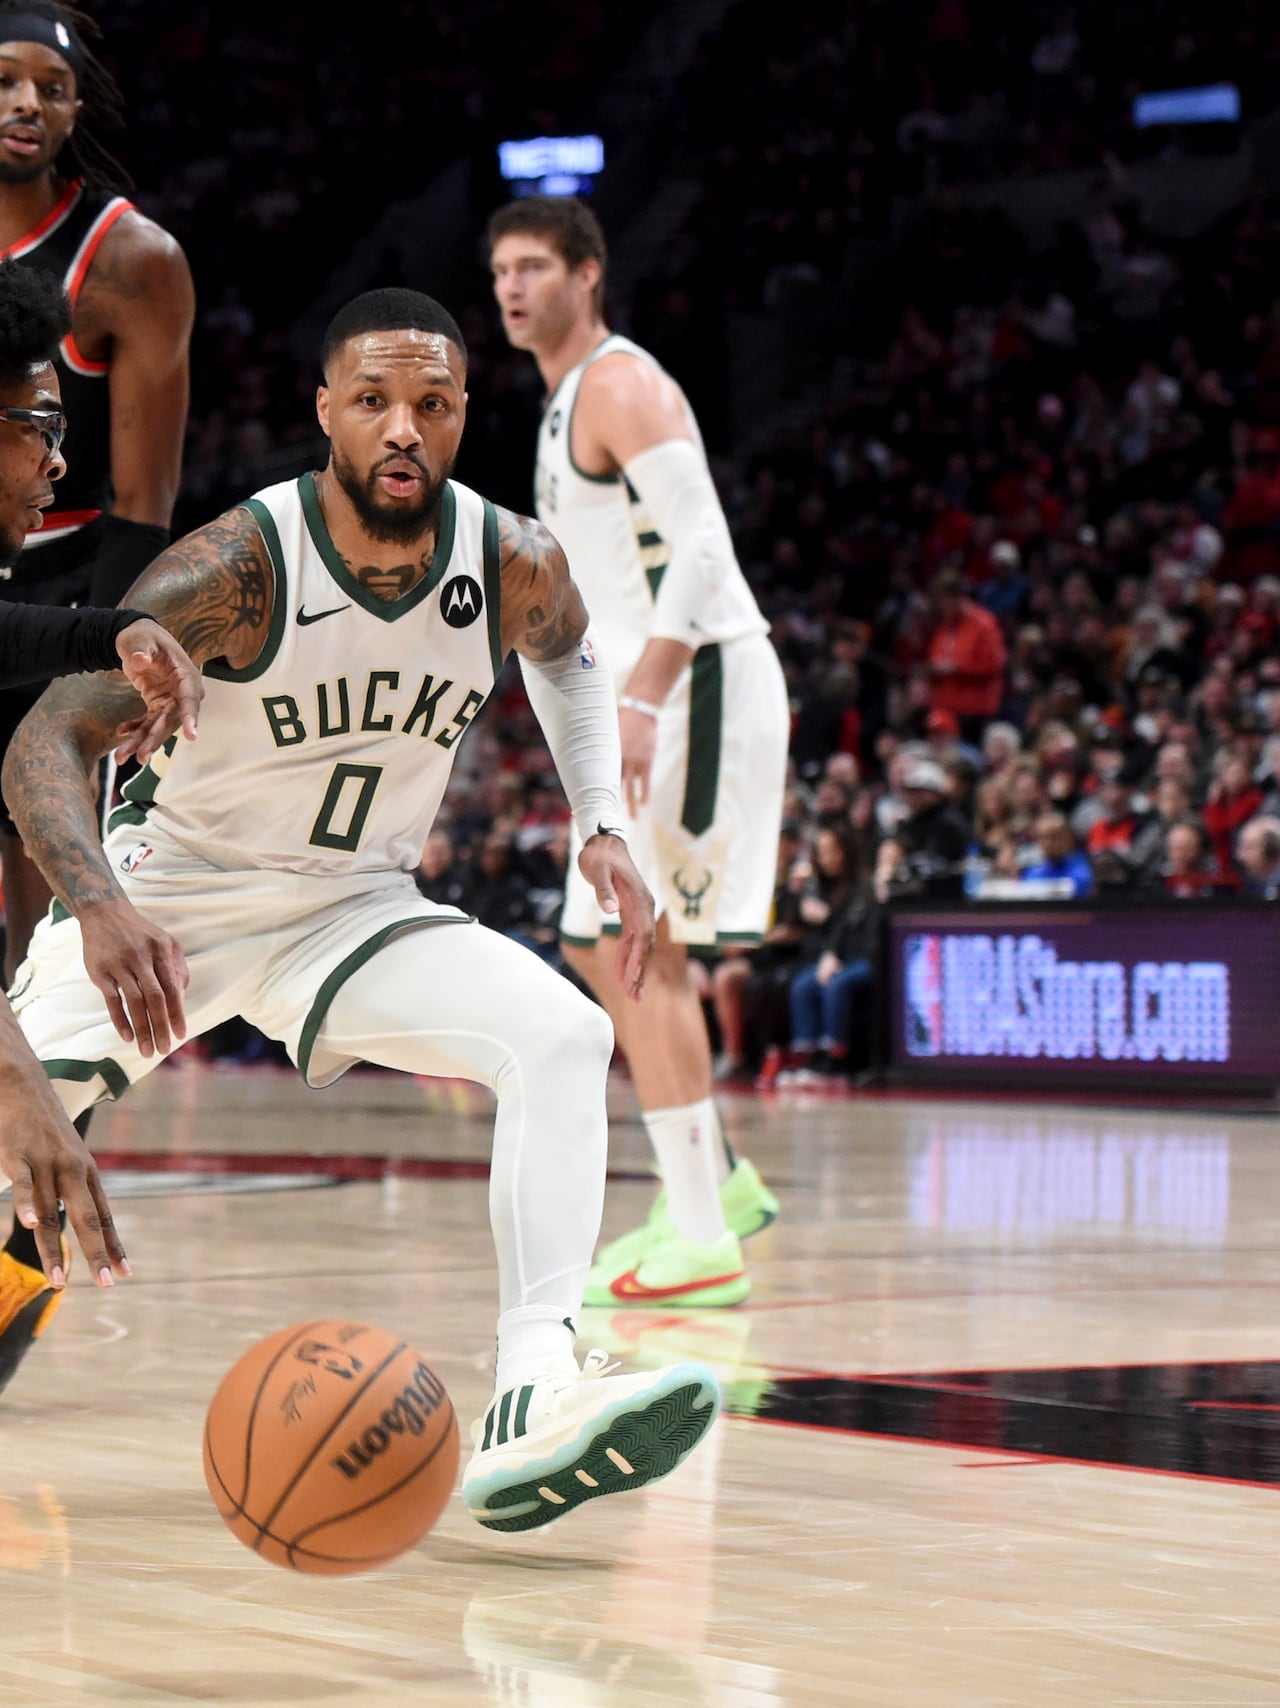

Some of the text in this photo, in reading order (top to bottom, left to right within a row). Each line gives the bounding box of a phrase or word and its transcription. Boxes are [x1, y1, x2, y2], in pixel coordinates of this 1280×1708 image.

[260, 670, 486, 749] BUCKS
[308, 761, 386, 854] 0
[331, 1361, 447, 1480] Wilson
